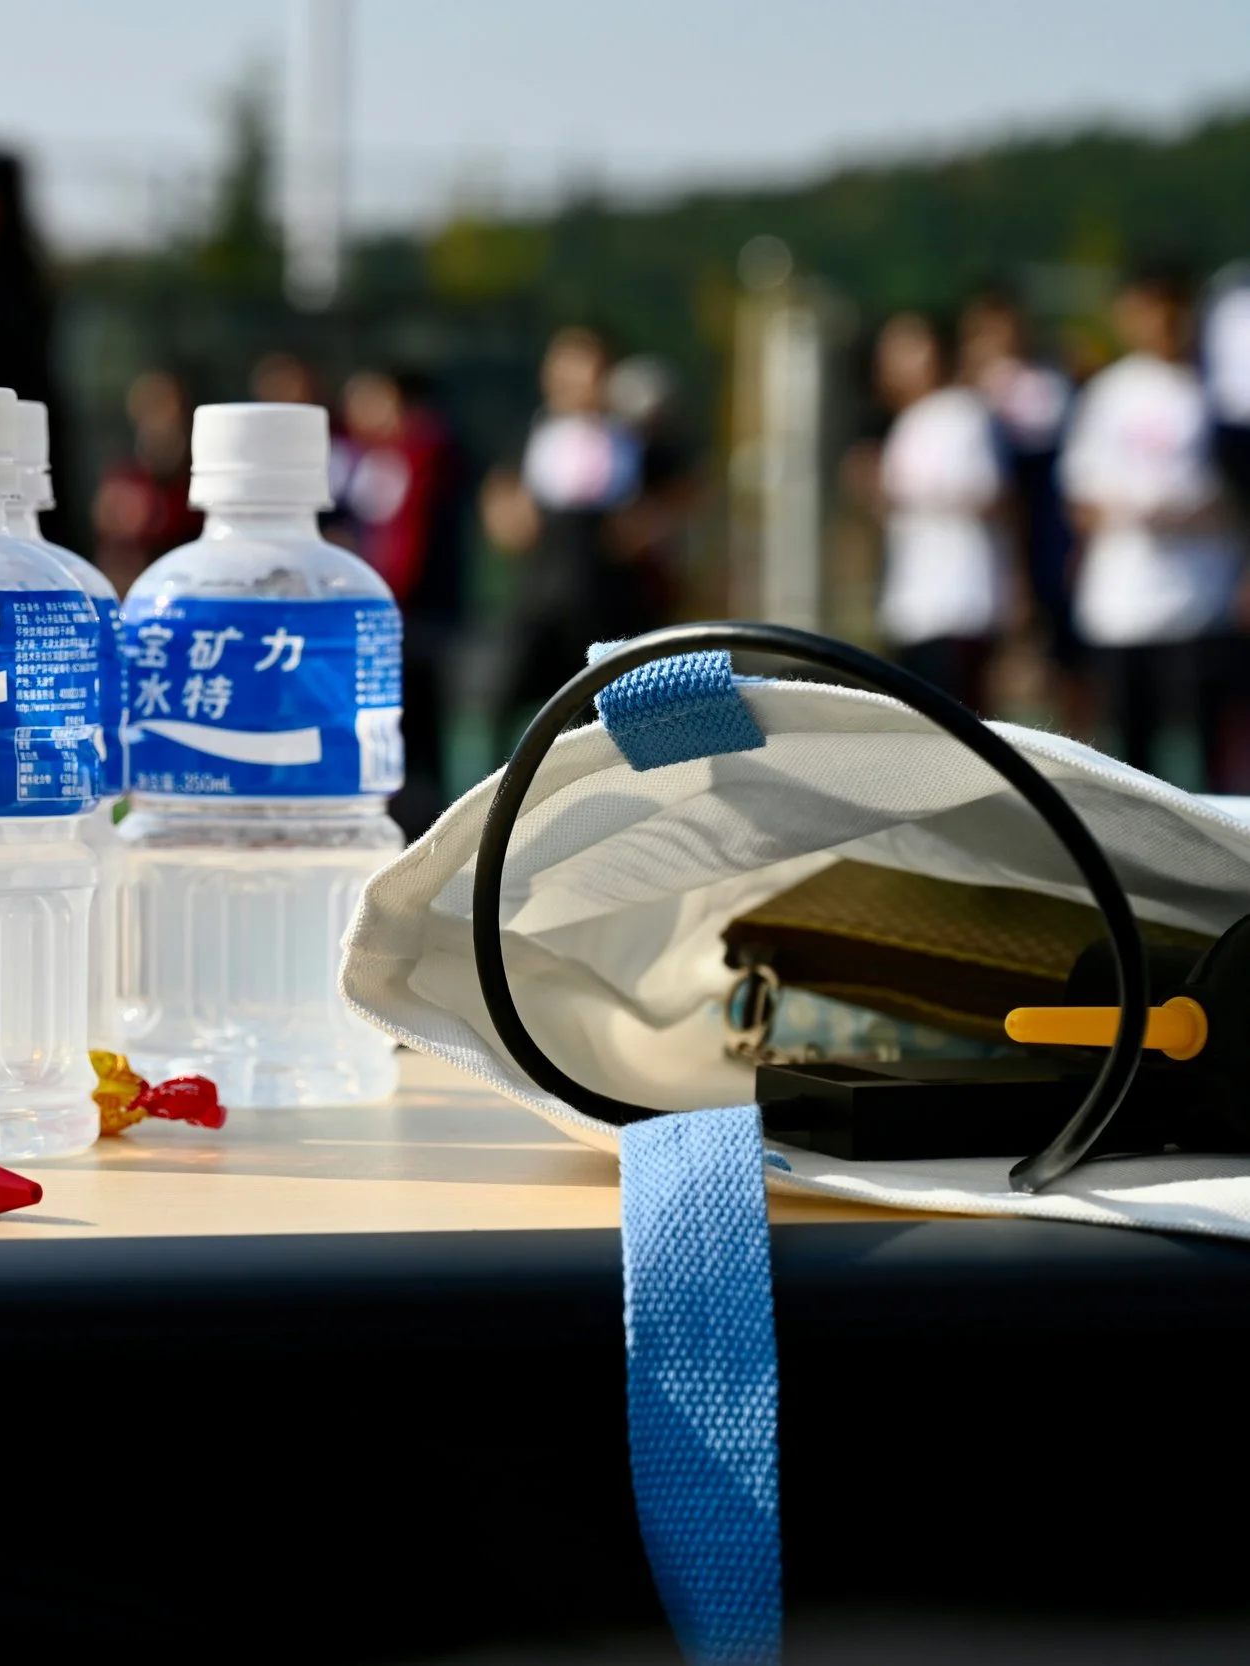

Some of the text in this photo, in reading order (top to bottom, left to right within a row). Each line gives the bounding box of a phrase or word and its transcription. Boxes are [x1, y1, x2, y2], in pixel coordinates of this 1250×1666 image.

[135, 624, 305, 672] 宝矿力
[134, 672, 233, 720] 水特
